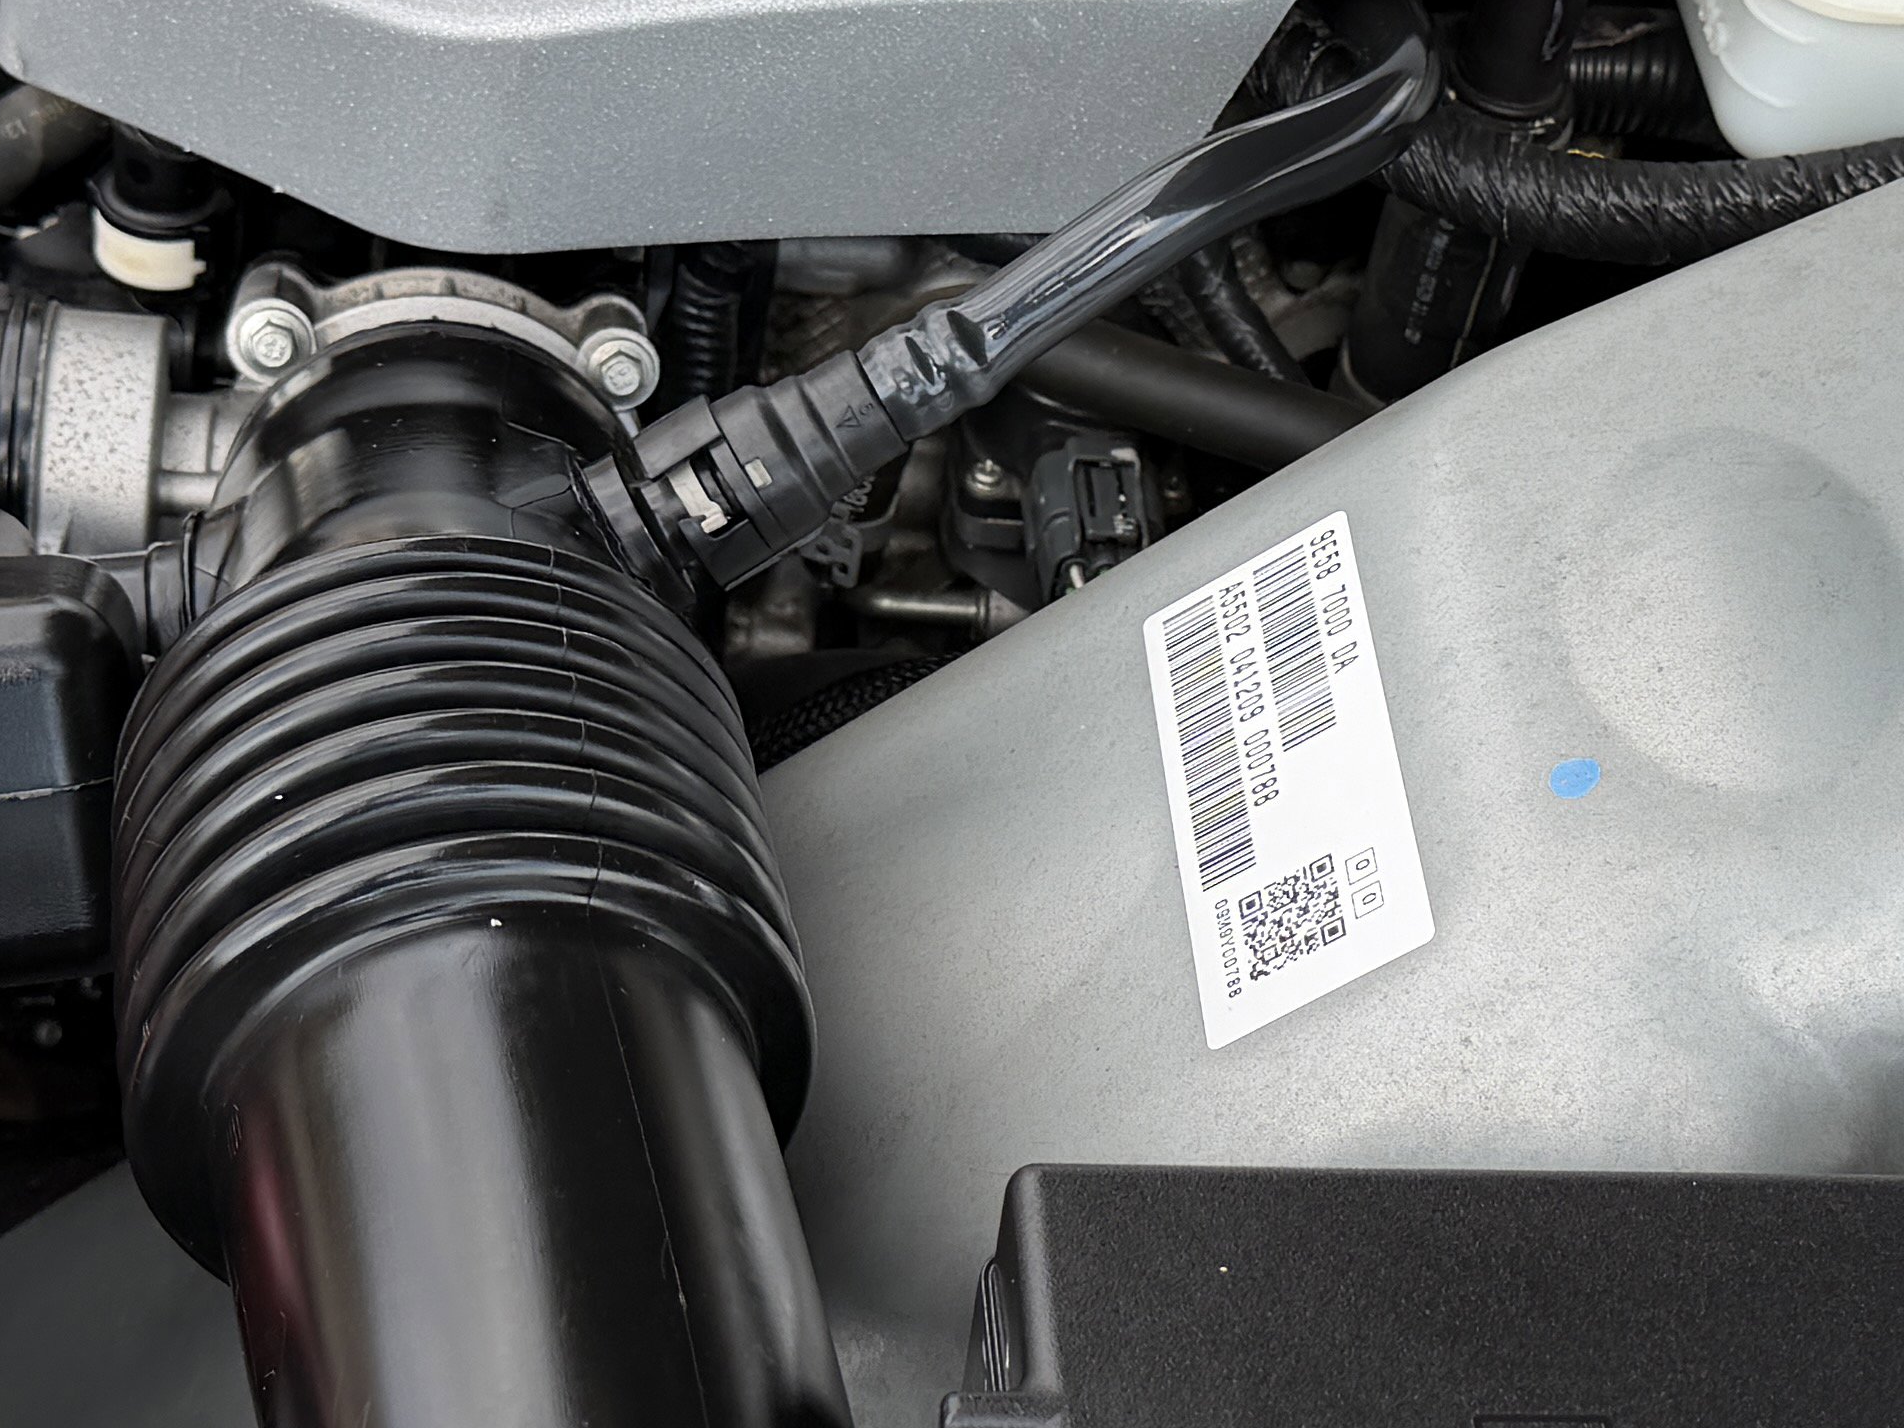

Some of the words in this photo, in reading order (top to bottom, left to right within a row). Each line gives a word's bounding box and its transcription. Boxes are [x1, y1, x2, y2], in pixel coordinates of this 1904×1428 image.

[1309, 528, 1341, 581] 9E58
[1218, 579, 1252, 643] A5502
[1319, 583, 1353, 638] 7000
[1229, 646, 1266, 724] 041209
[1243, 727, 1280, 808] 000788
